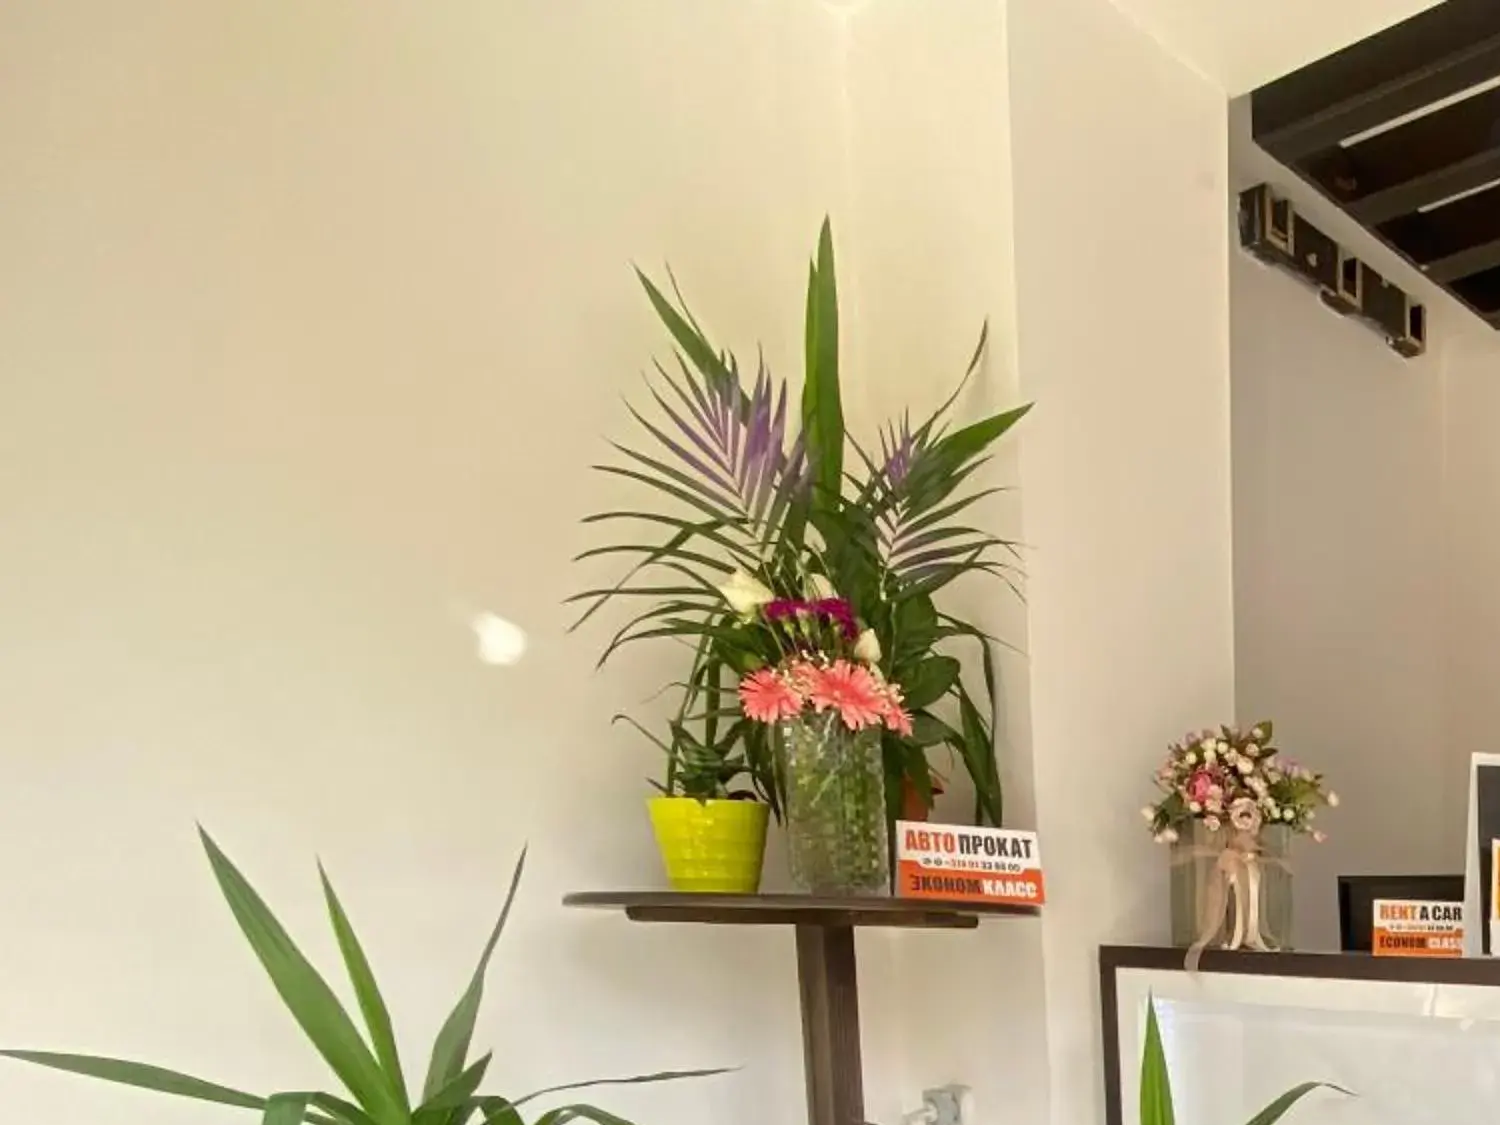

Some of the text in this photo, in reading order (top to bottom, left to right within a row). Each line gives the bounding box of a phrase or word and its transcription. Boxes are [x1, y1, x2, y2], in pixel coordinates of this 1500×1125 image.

[905, 829, 1032, 859] АВТО ПРОКАТ
[1419, 905, 1430, 921] A
[1431, 905, 1463, 921] CAR
